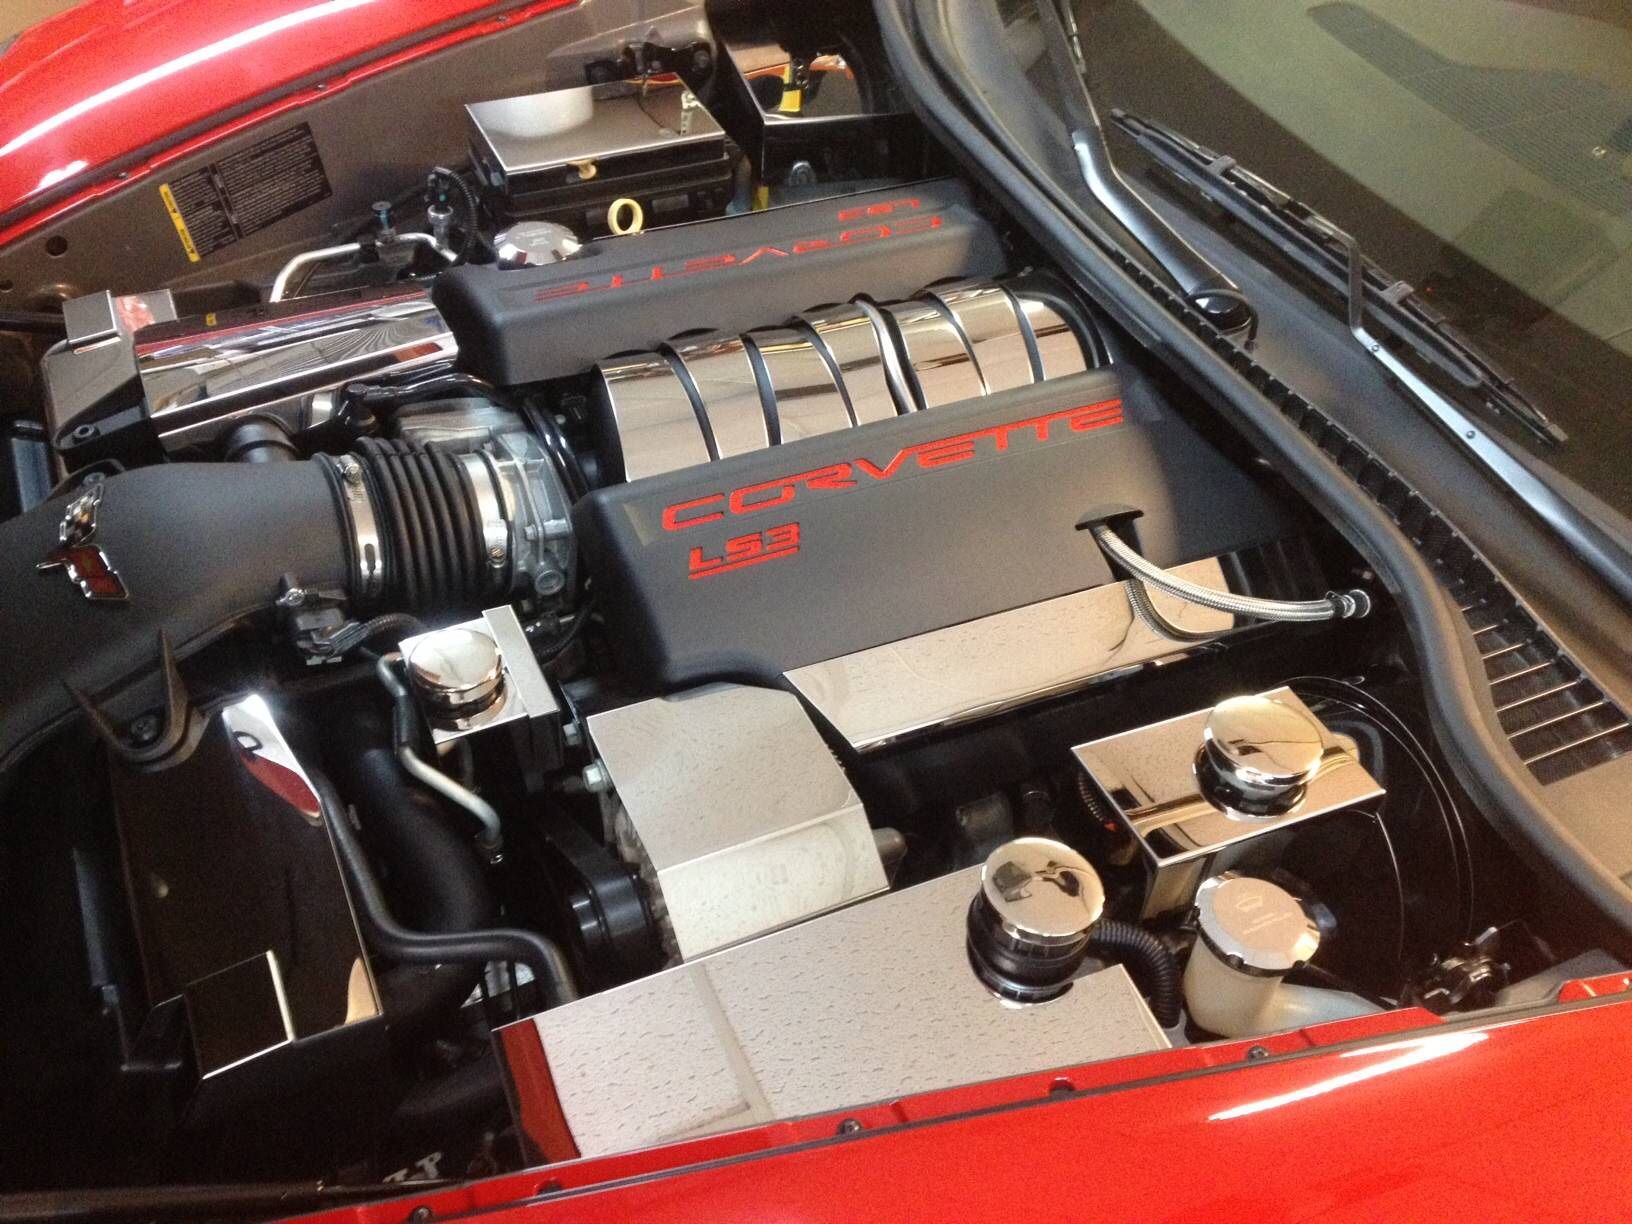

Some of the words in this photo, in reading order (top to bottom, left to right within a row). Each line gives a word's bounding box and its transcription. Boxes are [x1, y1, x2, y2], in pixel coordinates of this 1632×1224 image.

[535, 215, 944, 300] CORVETTE
[661, 398, 1124, 533] CORVETTE
[688, 522, 801, 575] LS3
